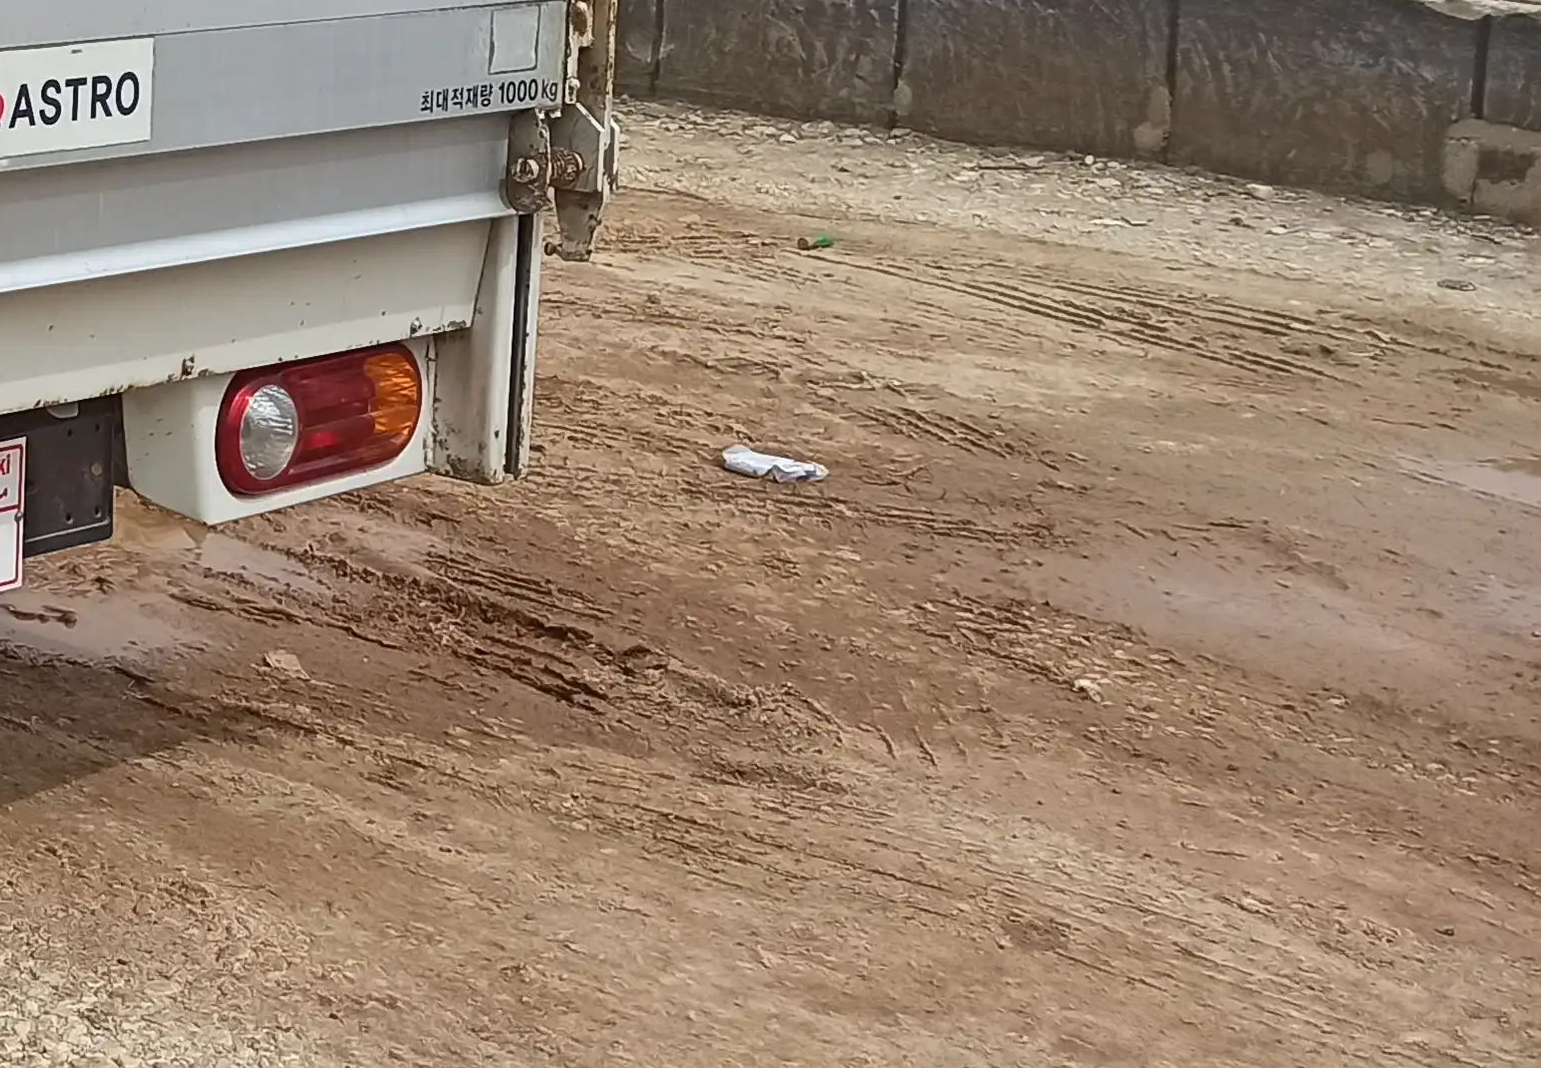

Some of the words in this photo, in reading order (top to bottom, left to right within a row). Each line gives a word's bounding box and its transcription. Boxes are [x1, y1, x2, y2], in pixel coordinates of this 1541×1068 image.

[420, 83, 494, 114] 최대적재량
[498, 78, 539, 104] 1000
[541, 79, 559, 102] kg
